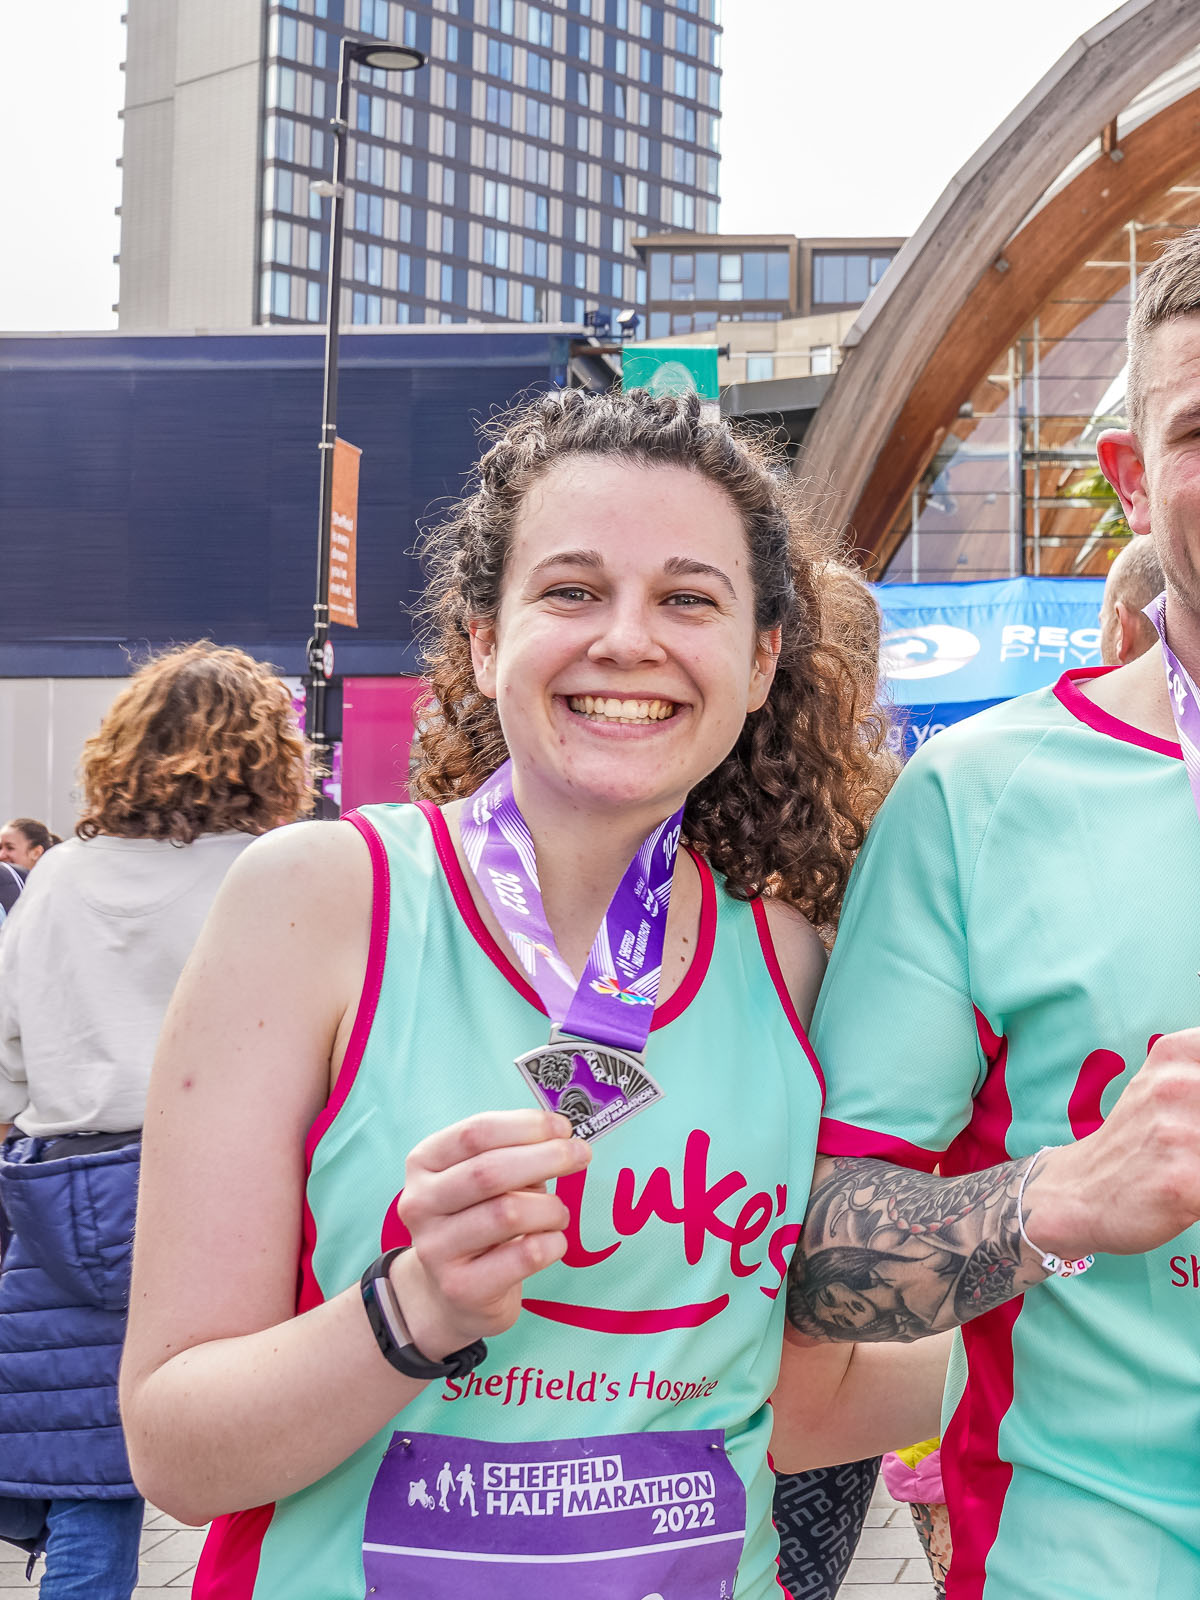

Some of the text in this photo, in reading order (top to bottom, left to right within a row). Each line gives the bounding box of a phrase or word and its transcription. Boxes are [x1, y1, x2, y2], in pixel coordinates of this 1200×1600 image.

[488, 868, 530, 915] 2022
[441, 1366, 719, 1407] Sheffield's Hospice
[487, 1458, 620, 1489] SHEFFIELD
[486, 1473, 714, 1517] HALF MARATHON
[651, 1501, 716, 1536] 2022
